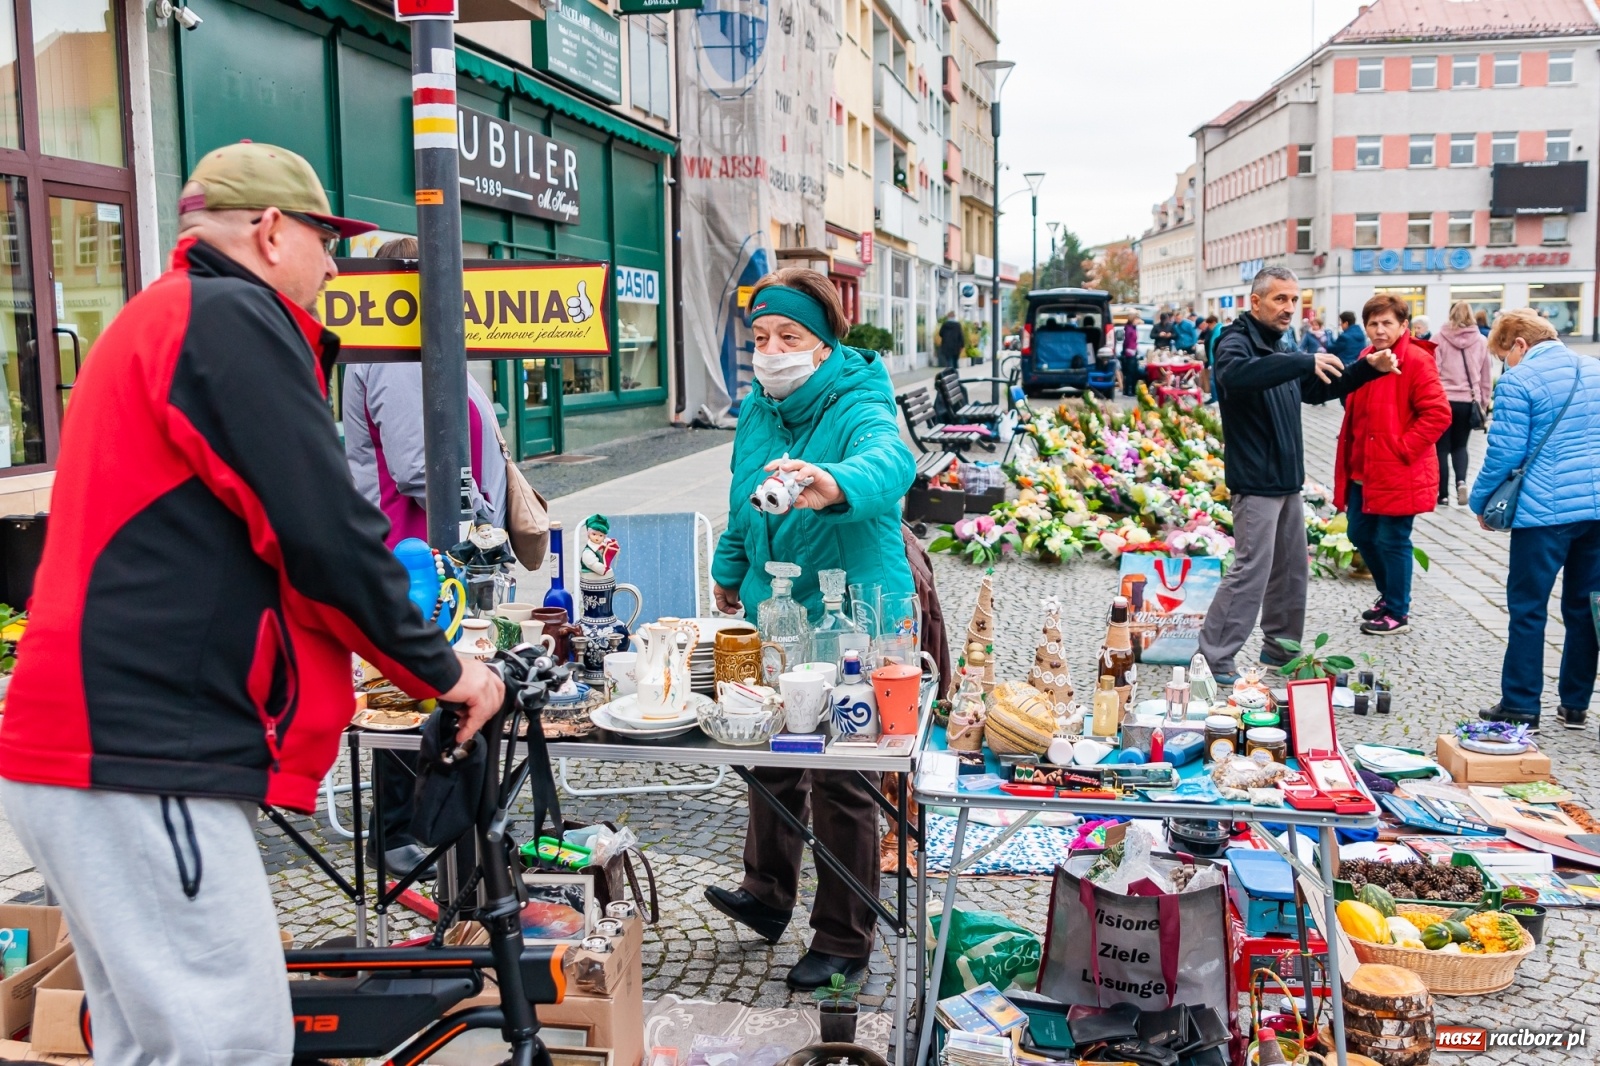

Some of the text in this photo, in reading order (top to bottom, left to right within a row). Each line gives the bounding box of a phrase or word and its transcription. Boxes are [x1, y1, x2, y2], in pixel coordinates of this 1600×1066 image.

[458, 110, 579, 191] UBILER
[475, 176, 502, 197] 1989
[1353, 247, 1472, 272] BOLKO
[616, 269, 655, 299] CASIO
[325, 289, 570, 329] DŁOAJNIA
[486, 326, 534, 340] domowe
[533, 325, 591, 343] jedzenie!
[1160, 627, 1200, 639] kochas
[1095, 908, 1160, 931] isione
[1098, 942, 1150, 963] Ziele
[293, 1015, 339, 1032] na
